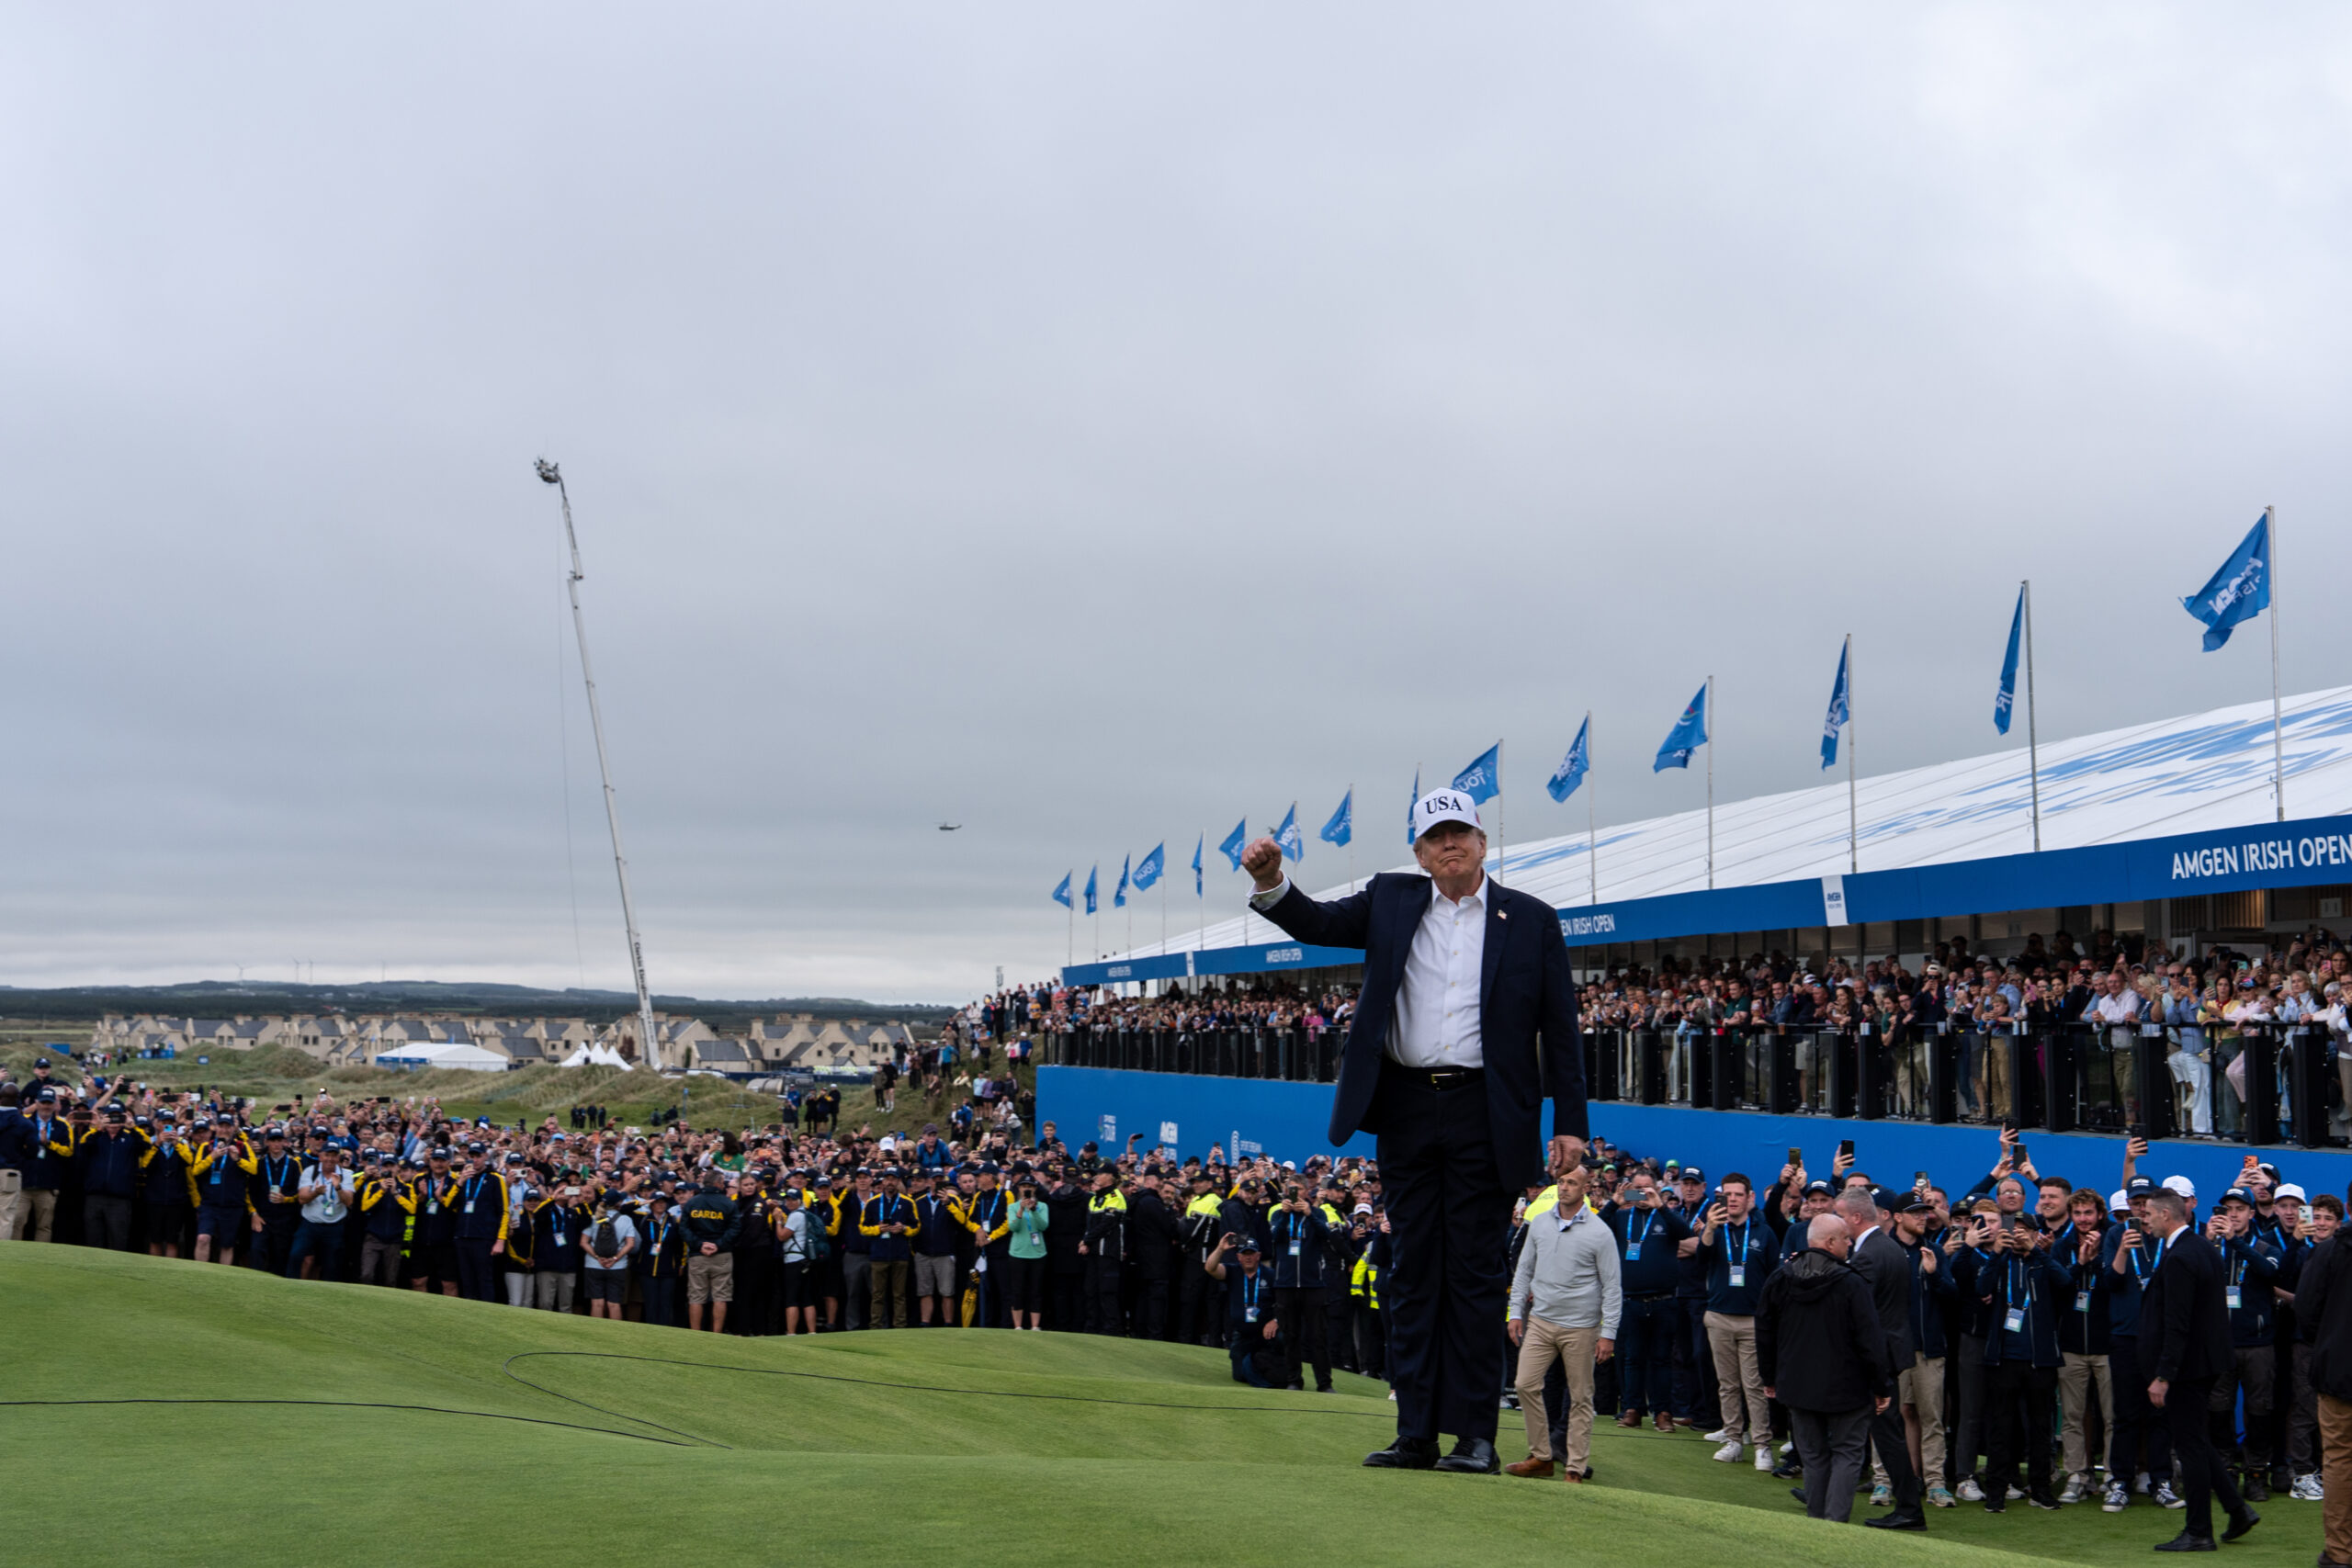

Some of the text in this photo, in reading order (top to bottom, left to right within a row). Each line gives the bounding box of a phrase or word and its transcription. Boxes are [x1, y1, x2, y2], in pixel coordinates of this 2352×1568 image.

[1425, 795, 1464, 815] USA
[2171, 834, 2352, 880] AMGEN IRISH OPEN
[1593, 914, 1615, 933] OPEN
[690, 1209, 724, 1220] GARDA
